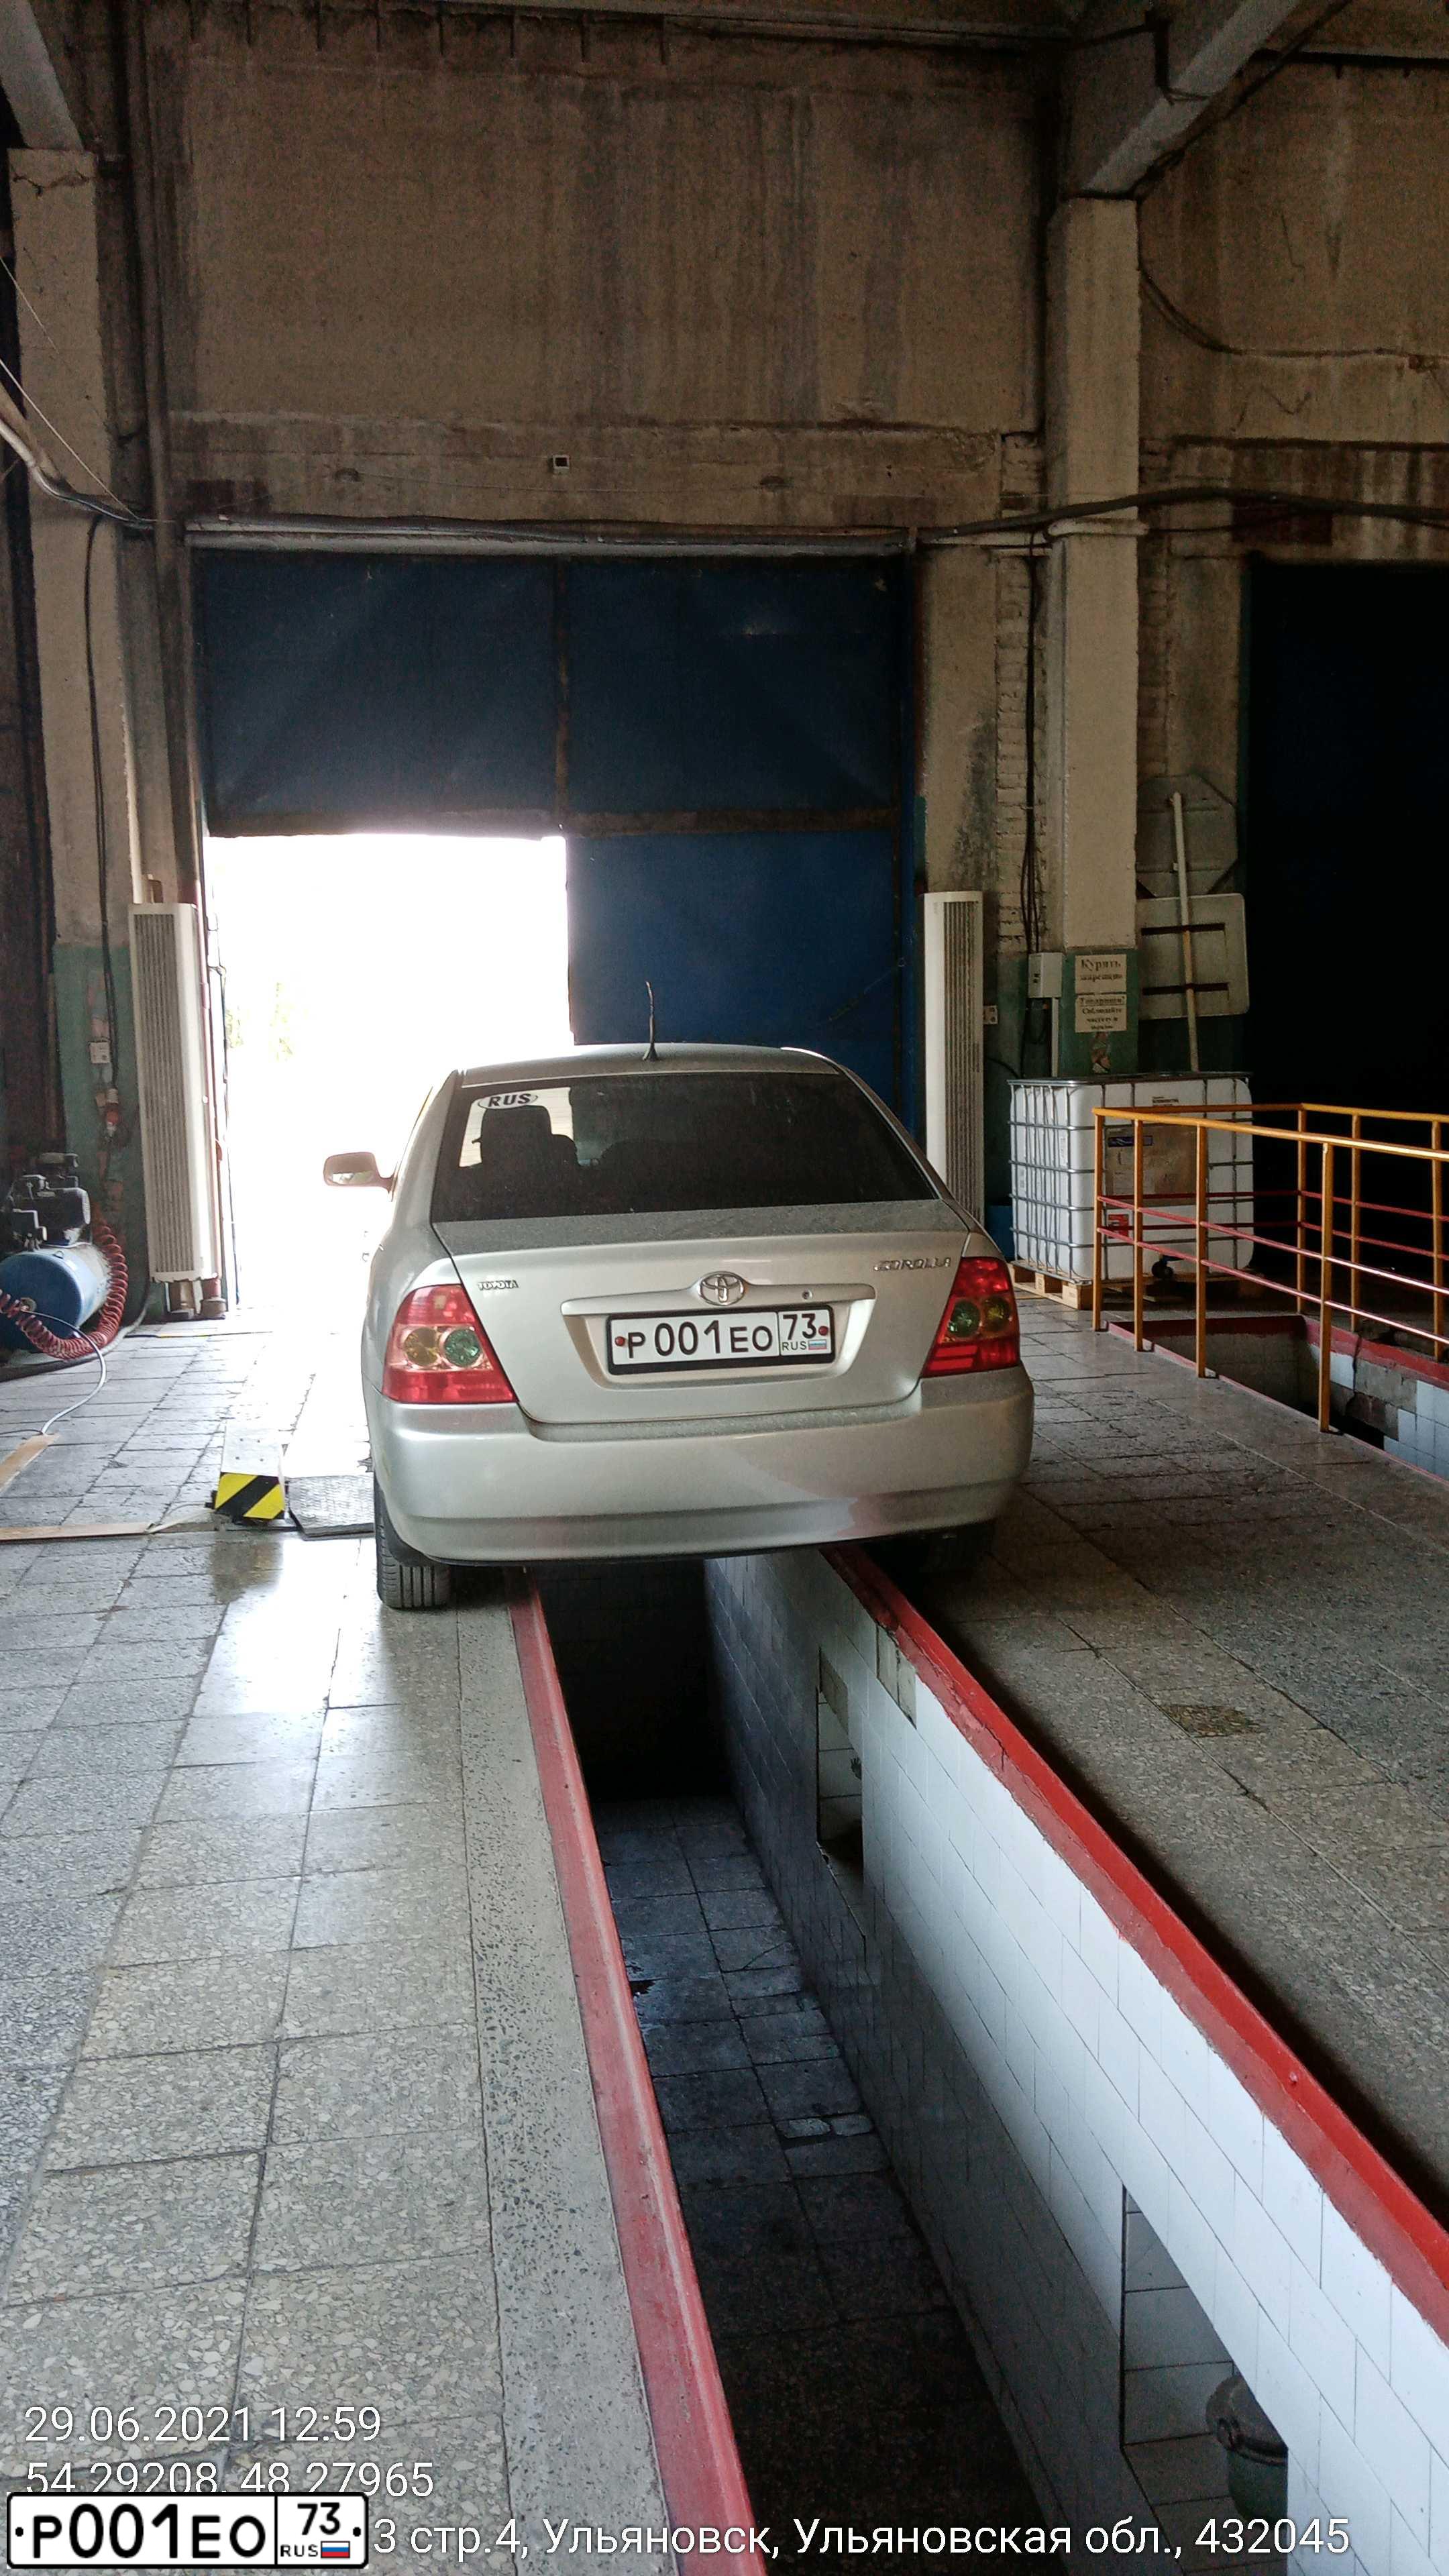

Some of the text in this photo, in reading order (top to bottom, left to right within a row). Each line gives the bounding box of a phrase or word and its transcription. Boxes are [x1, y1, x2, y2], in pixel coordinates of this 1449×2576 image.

[1081, 959, 1121, 972] Курить
[488, 1093, 532, 1108] RUS
[477, 1279, 519, 1291] TOYOTA
[782, 1313, 817, 1340] 73
[782, 1341, 807, 1351] RUS
